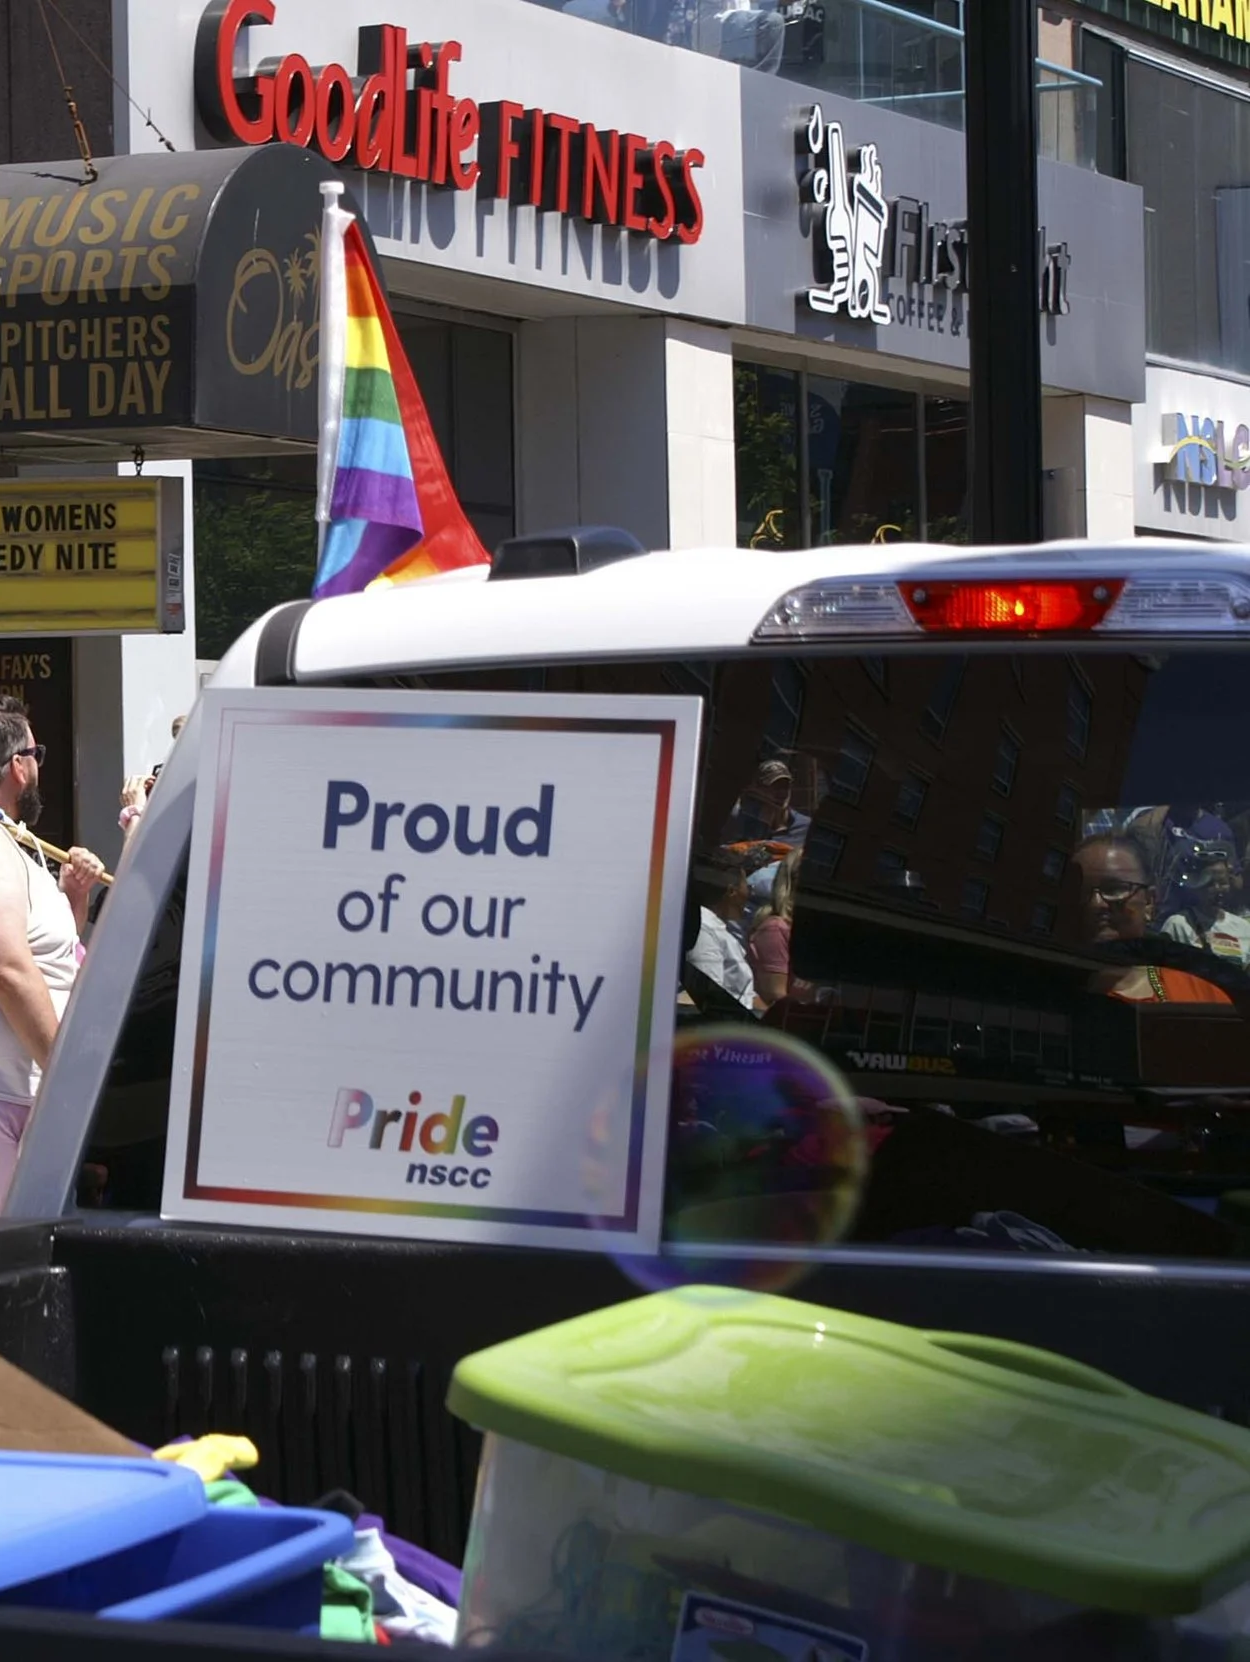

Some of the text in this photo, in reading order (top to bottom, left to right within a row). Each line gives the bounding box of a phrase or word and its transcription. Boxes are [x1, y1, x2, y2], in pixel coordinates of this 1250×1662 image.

[208, 0, 705, 245] GoodLife FITNESS
[890, 195, 968, 290] Firs
[0, 315, 172, 363] PITCHERS
[226, 248, 320, 392] Oas
[87, 360, 172, 418] DAY
[1, 503, 118, 532] WOMENS
[55, 541, 118, 570] NITE
[322, 780, 555, 857] Proud
[337, 873, 526, 938] of our
[248, 954, 605, 1032] community
[327, 1087, 499, 1157] Pride
[405, 1163, 492, 1189] nscc
